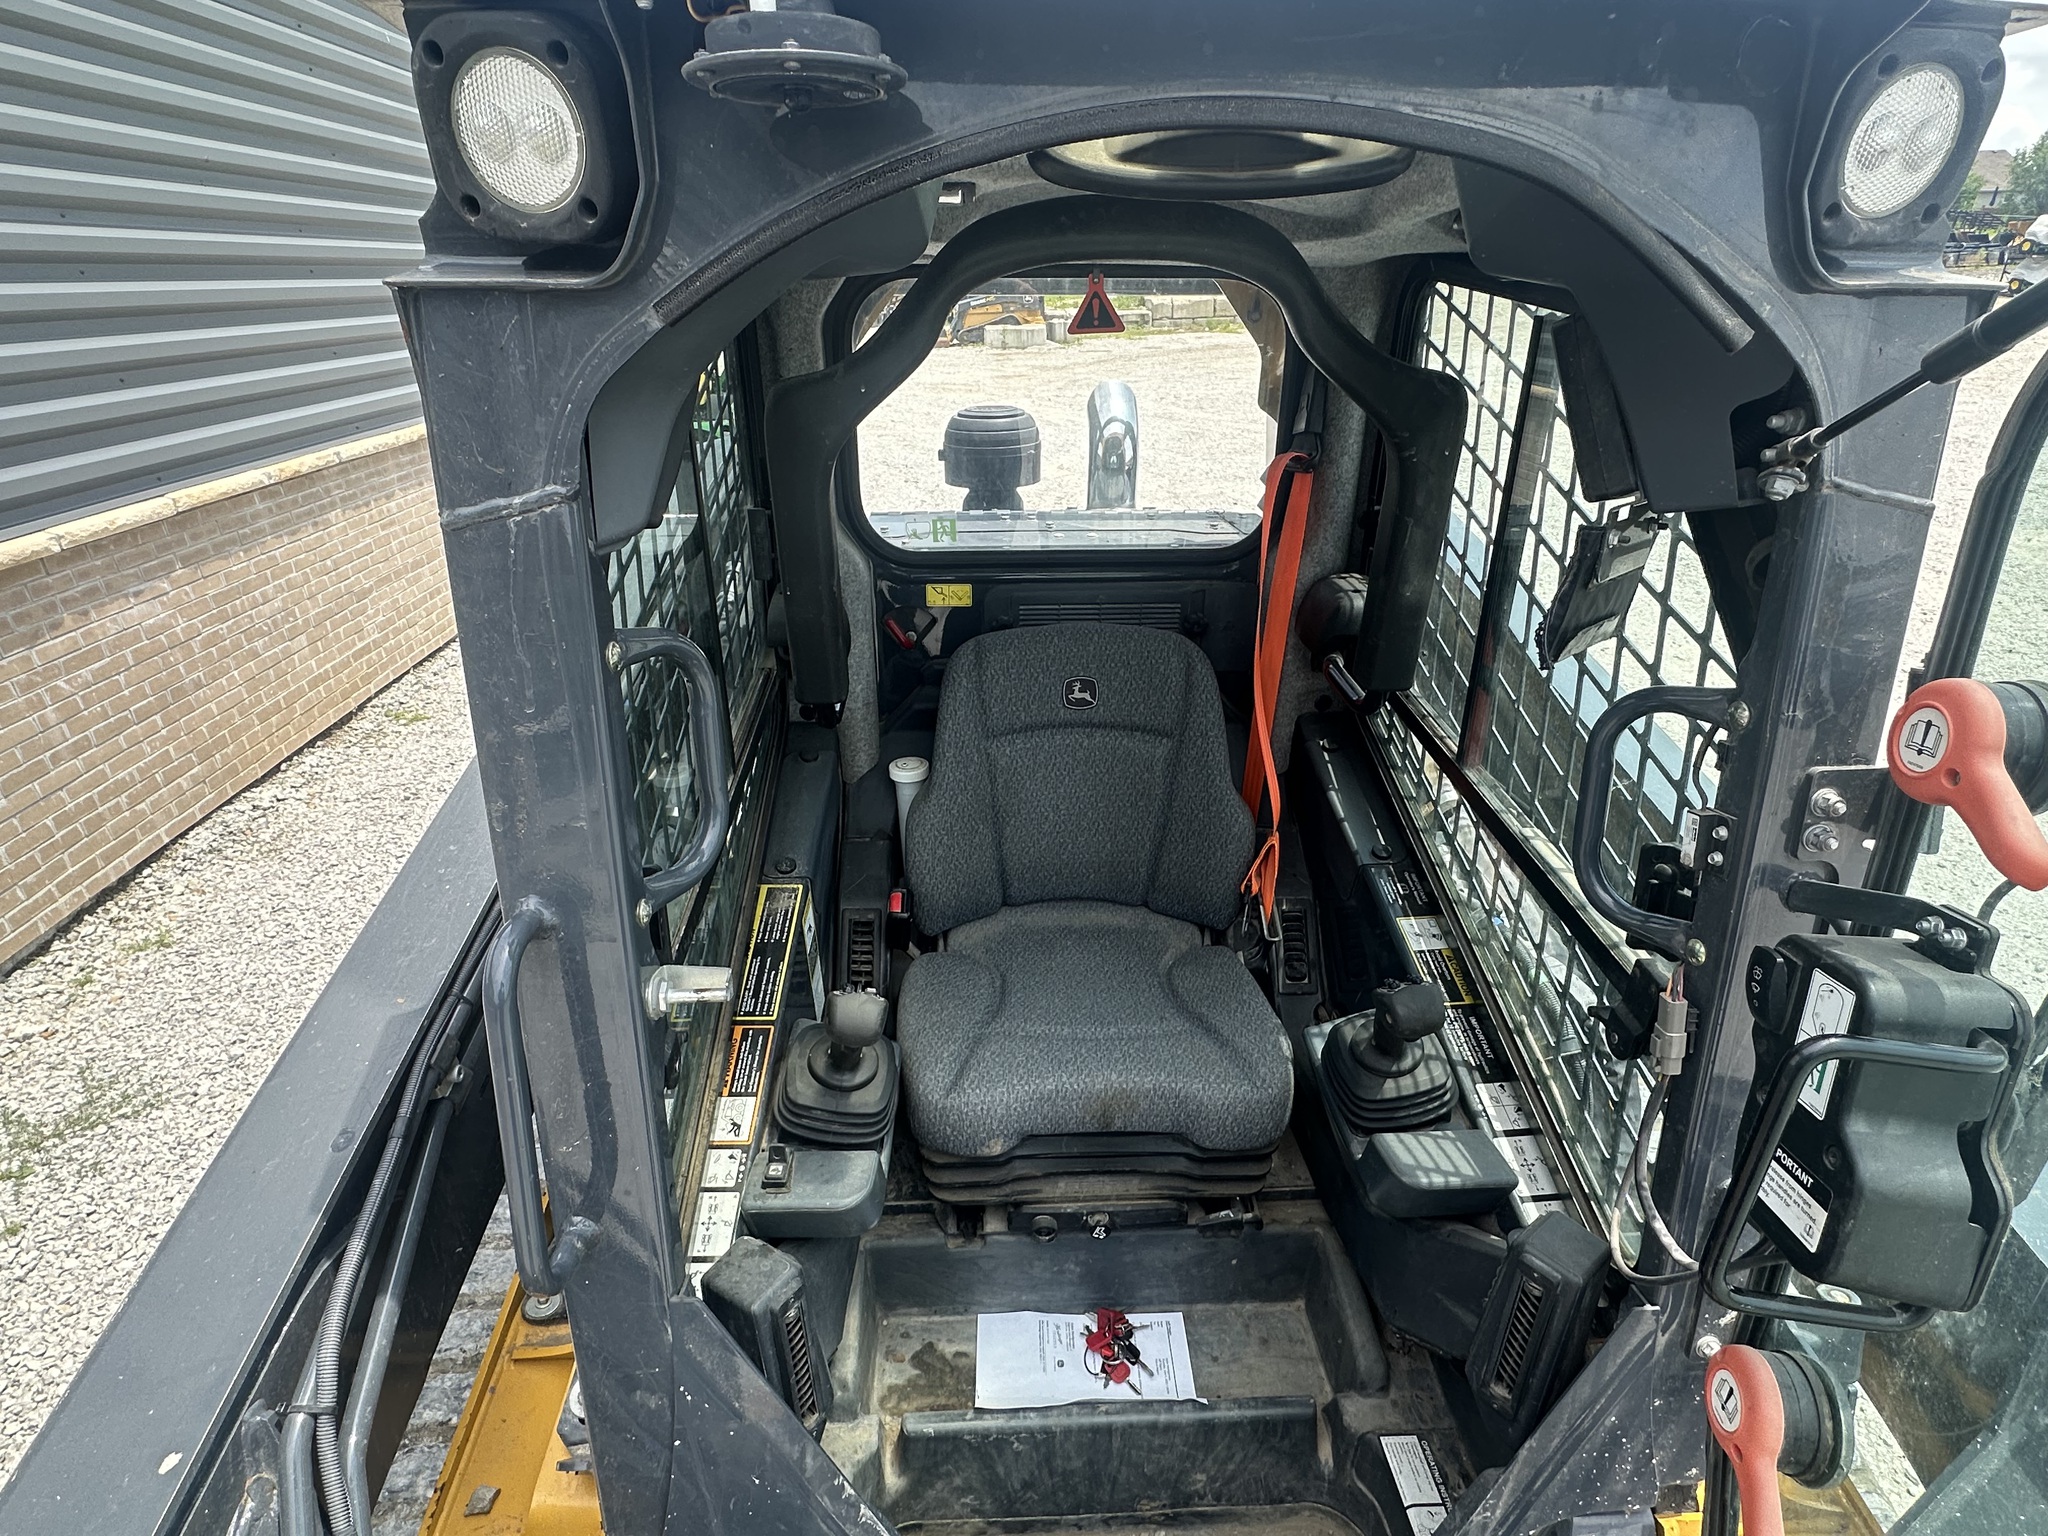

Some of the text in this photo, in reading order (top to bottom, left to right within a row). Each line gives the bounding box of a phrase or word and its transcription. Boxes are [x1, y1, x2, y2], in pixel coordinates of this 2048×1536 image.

[1450, 960, 1471, 996] CAUTION
[1469, 1016, 1494, 1059] IMPORTANT
[1775, 1147, 1814, 1188] PORTANT
[1421, 1440, 1443, 1484] OPERATING
